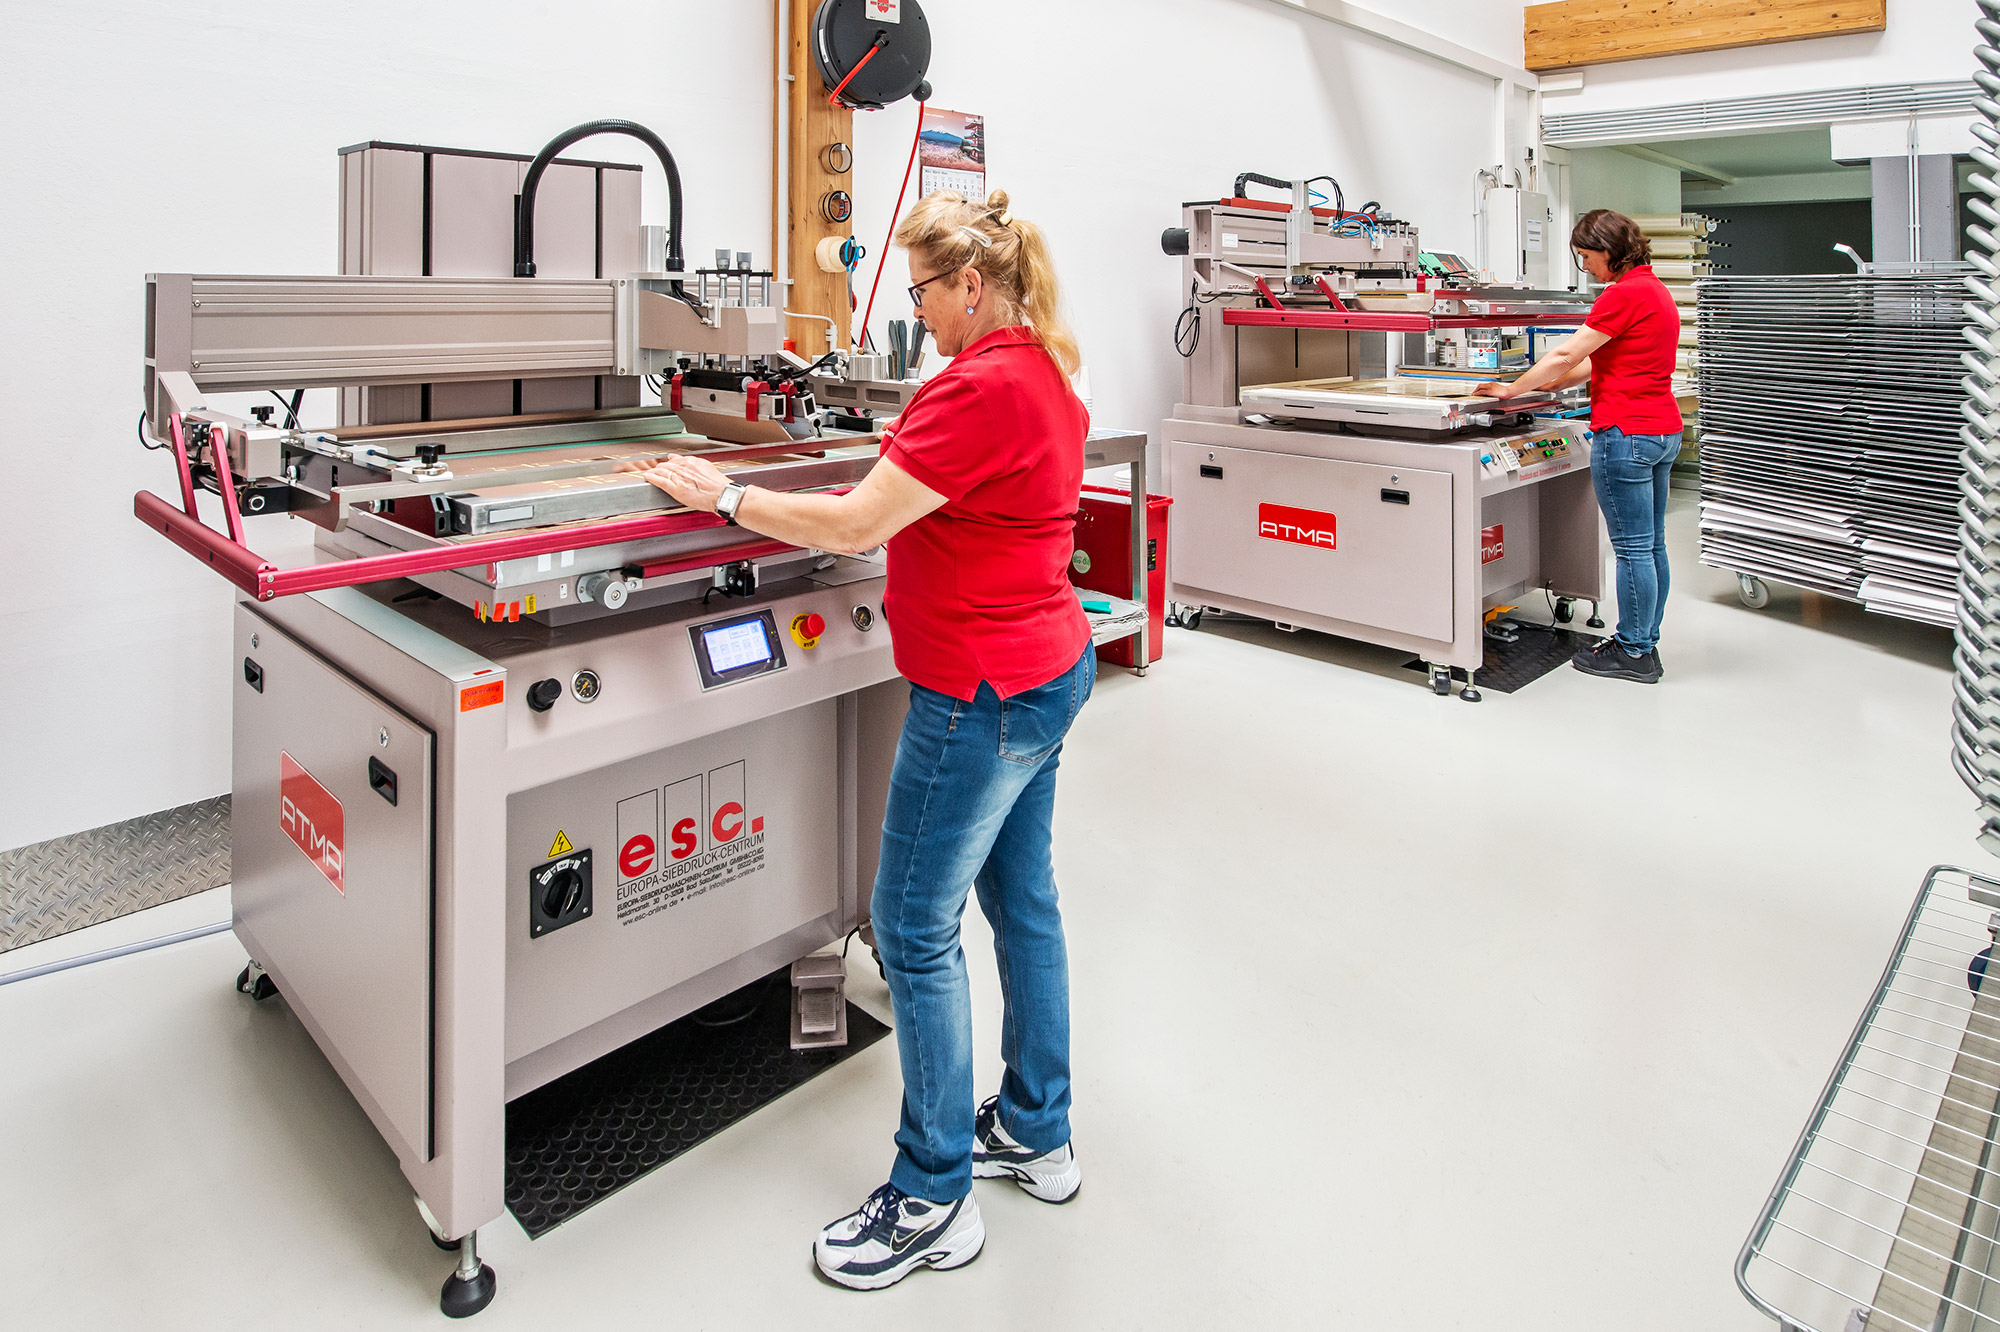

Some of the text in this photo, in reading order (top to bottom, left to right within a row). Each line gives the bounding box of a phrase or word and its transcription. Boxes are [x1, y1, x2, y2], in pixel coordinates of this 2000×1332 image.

[1261, 521, 1335, 546] ATMA
[1481, 542, 1504, 560] TMA
[281, 795, 343, 881] ATMA
[616, 832, 765, 901] EUROPA-SIEBDRUCK-CENTRUM
[616, 861, 728, 912] EUROPA-SIEBDRUCKMASCHINEN-CENTRUM
[653, 897, 660, 906] 30
[686, 882, 698, 892] Bad
